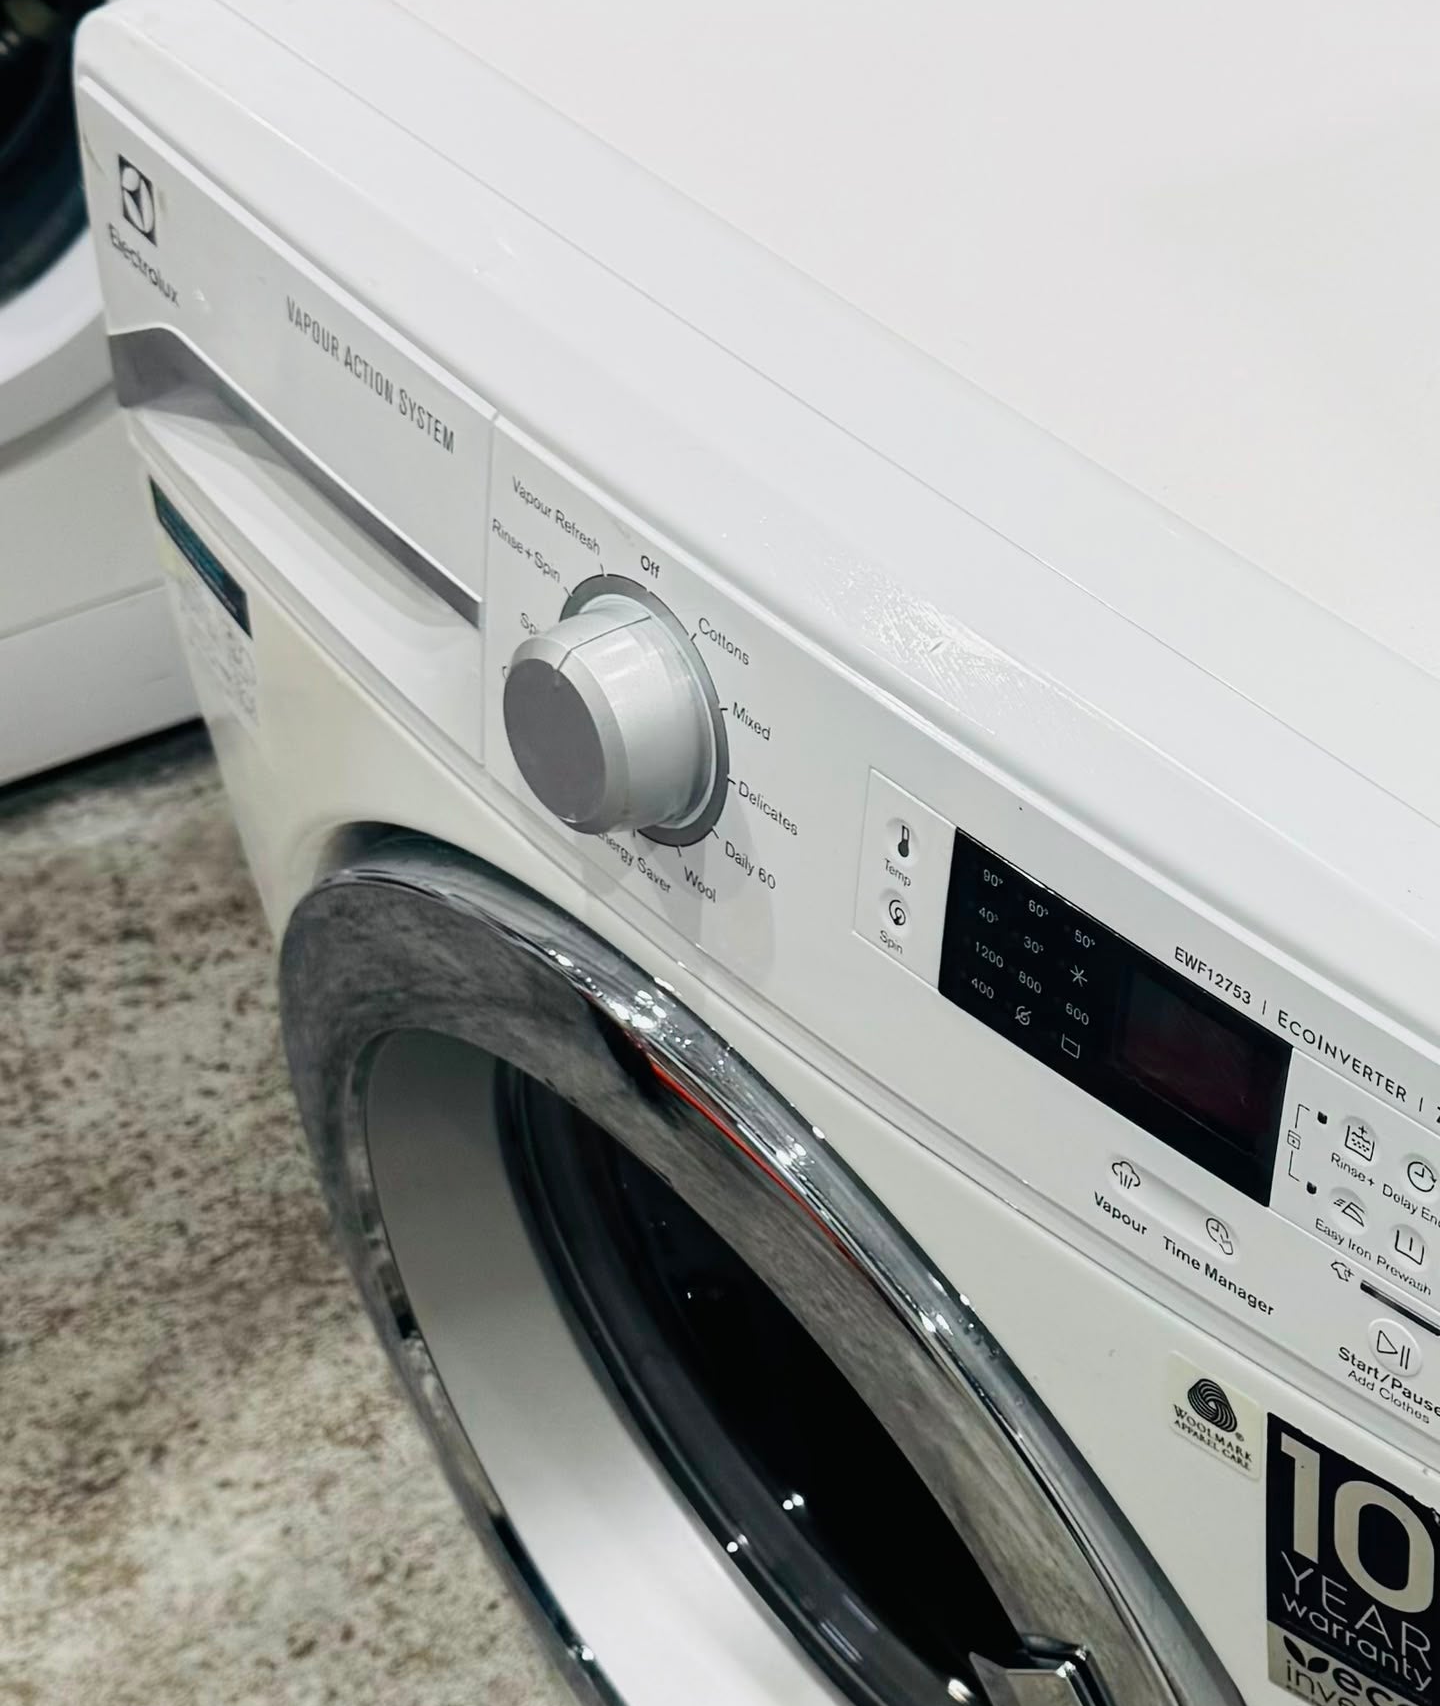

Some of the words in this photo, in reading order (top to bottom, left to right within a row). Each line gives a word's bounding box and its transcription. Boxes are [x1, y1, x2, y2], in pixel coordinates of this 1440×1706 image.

[107, 222, 181, 309] Electrolux
[286, 295, 341, 363] VAPOUR
[343, 346, 394, 406] ACTION
[398, 389, 455, 454] SYSTEM
[512, 475, 552, 518] Vapour
[555, 509, 601, 557] Refresh
[639, 555, 661, 579] Off
[698, 616, 751, 666] Cottons
[732, 701, 772, 741] Mixed
[738, 780, 799, 837] Delicates
[637, 856, 672, 893] Saver
[683, 865, 717, 903] Wool
[724, 840, 756, 877] Daily
[758, 867, 777, 890] 60
[884, 858, 912, 887] Temp
[879, 929, 904, 955] Spin
[975, 940, 1005, 969] 1200
[971, 977, 996, 1000] 400
[1018, 970, 1043, 994] 800
[1174, 946, 1252, 1005] EWF12753
[1065, 1002, 1090, 1026] 600
[1093, 1190, 1148, 1236] Vapour
[1382, 1183, 1419, 1215] Delay
[1315, 1217, 1345, 1246] Easy
[1349, 1238, 1372, 1261] Iron
[1162, 1235, 1201, 1271] Time
[1204, 1262, 1275, 1316] Manager
[1376, 1254, 1433, 1296] Prewash
[1347, 1370, 1376, 1391] Add
[1379, 1387, 1430, 1424] Clothes
[1172, 1403, 1253, 1464] WOOLMARK
[1174, 1419, 1220, 1453] APPAREL
[1222, 1448, 1251, 1471] CARE
[1280, 1431, 1436, 1614] 10
[1281, 1550, 1433, 1672] YEAR
[1281, 1591, 1433, 1693] warranty
